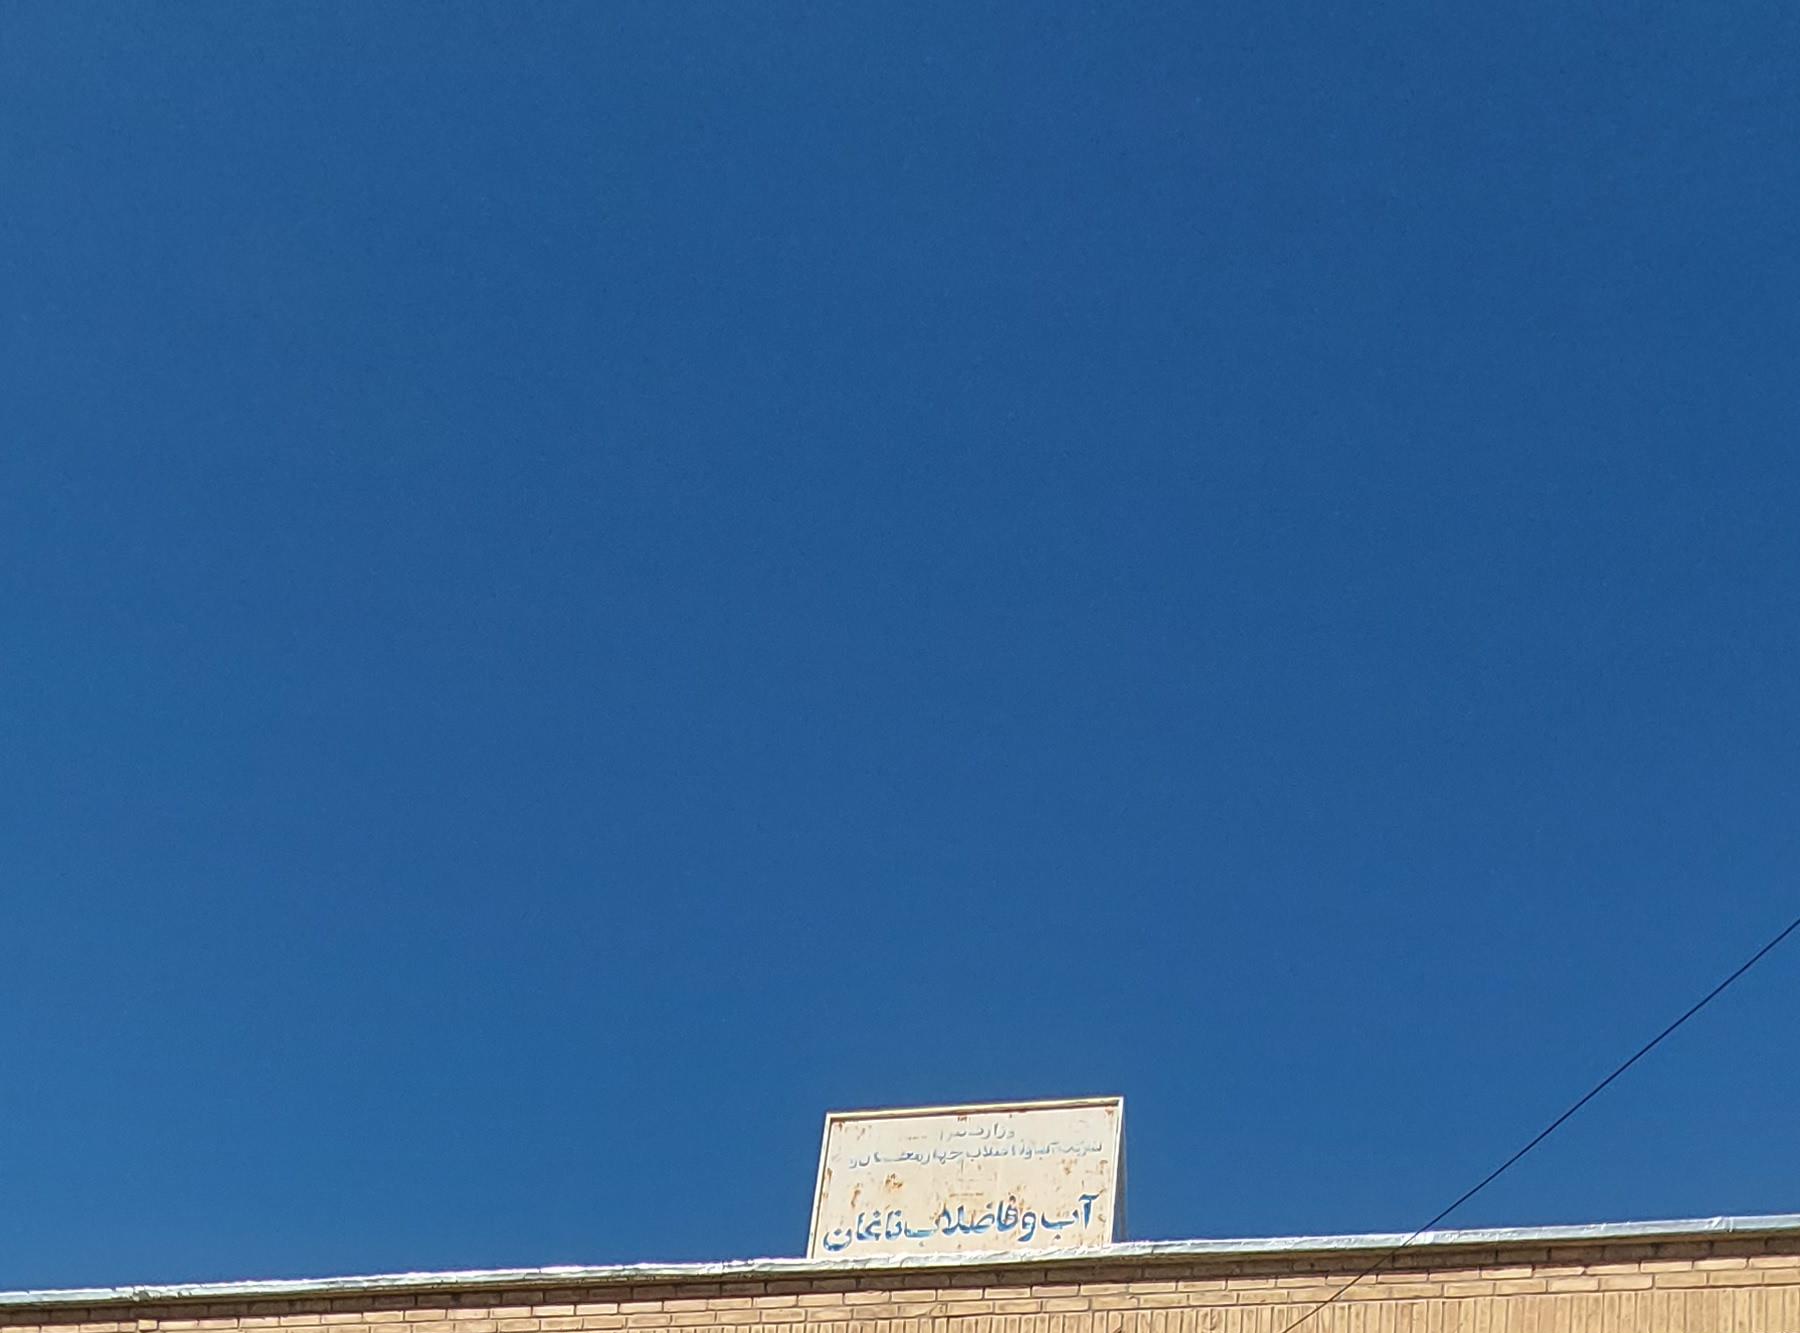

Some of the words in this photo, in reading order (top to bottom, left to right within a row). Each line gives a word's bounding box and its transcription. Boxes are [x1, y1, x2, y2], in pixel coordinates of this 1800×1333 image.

[904, 1195, 1018, 1248] فاضلاب
[1017, 1211, 1037, 1242] و
[1040, 1194, 1100, 1240] آب
